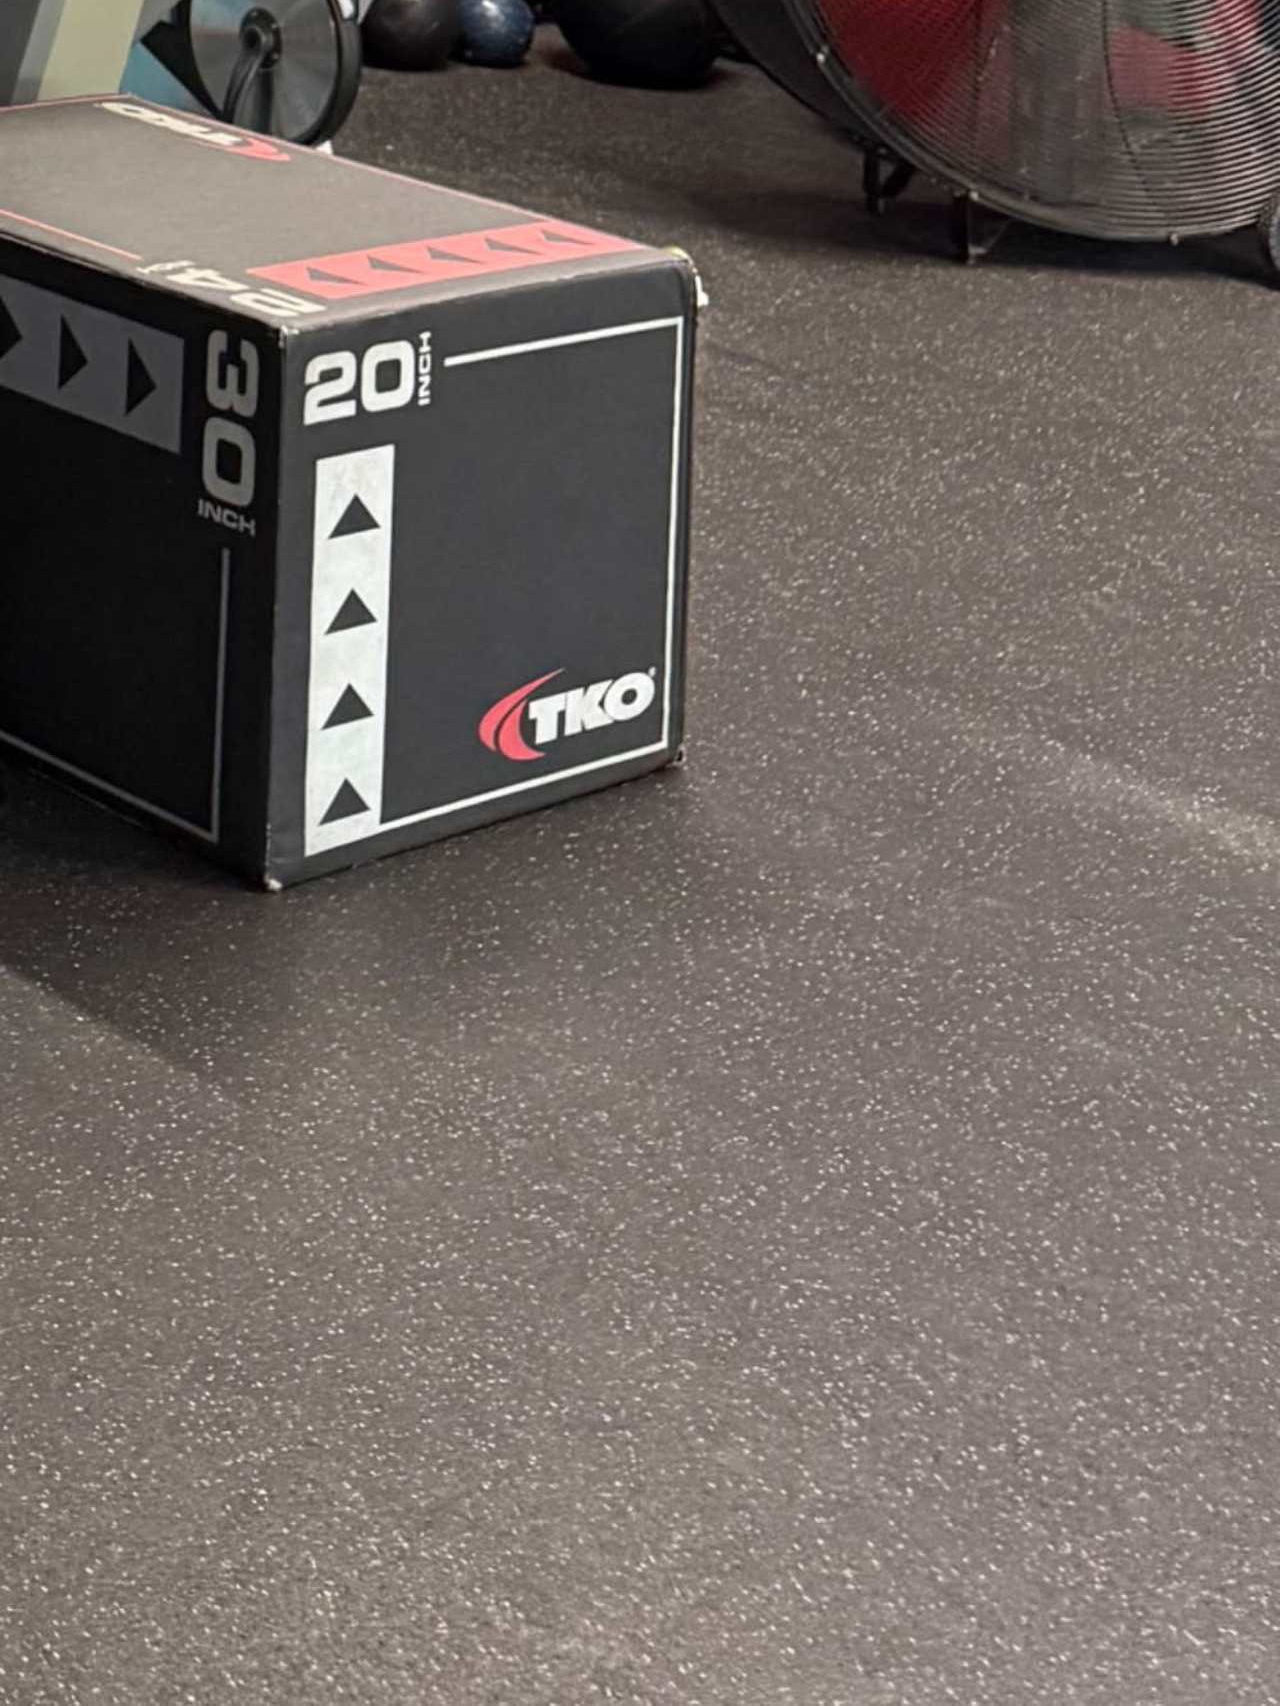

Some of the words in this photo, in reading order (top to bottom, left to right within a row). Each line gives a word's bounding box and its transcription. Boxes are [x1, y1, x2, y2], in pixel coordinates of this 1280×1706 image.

[166, 267, 327, 317] 24
[303, 340, 416, 426] 20
[417, 331, 432, 407] INCH
[202, 329, 260, 507] 30
[197, 498, 256, 537] INCH
[528, 672, 656, 745] TKO
